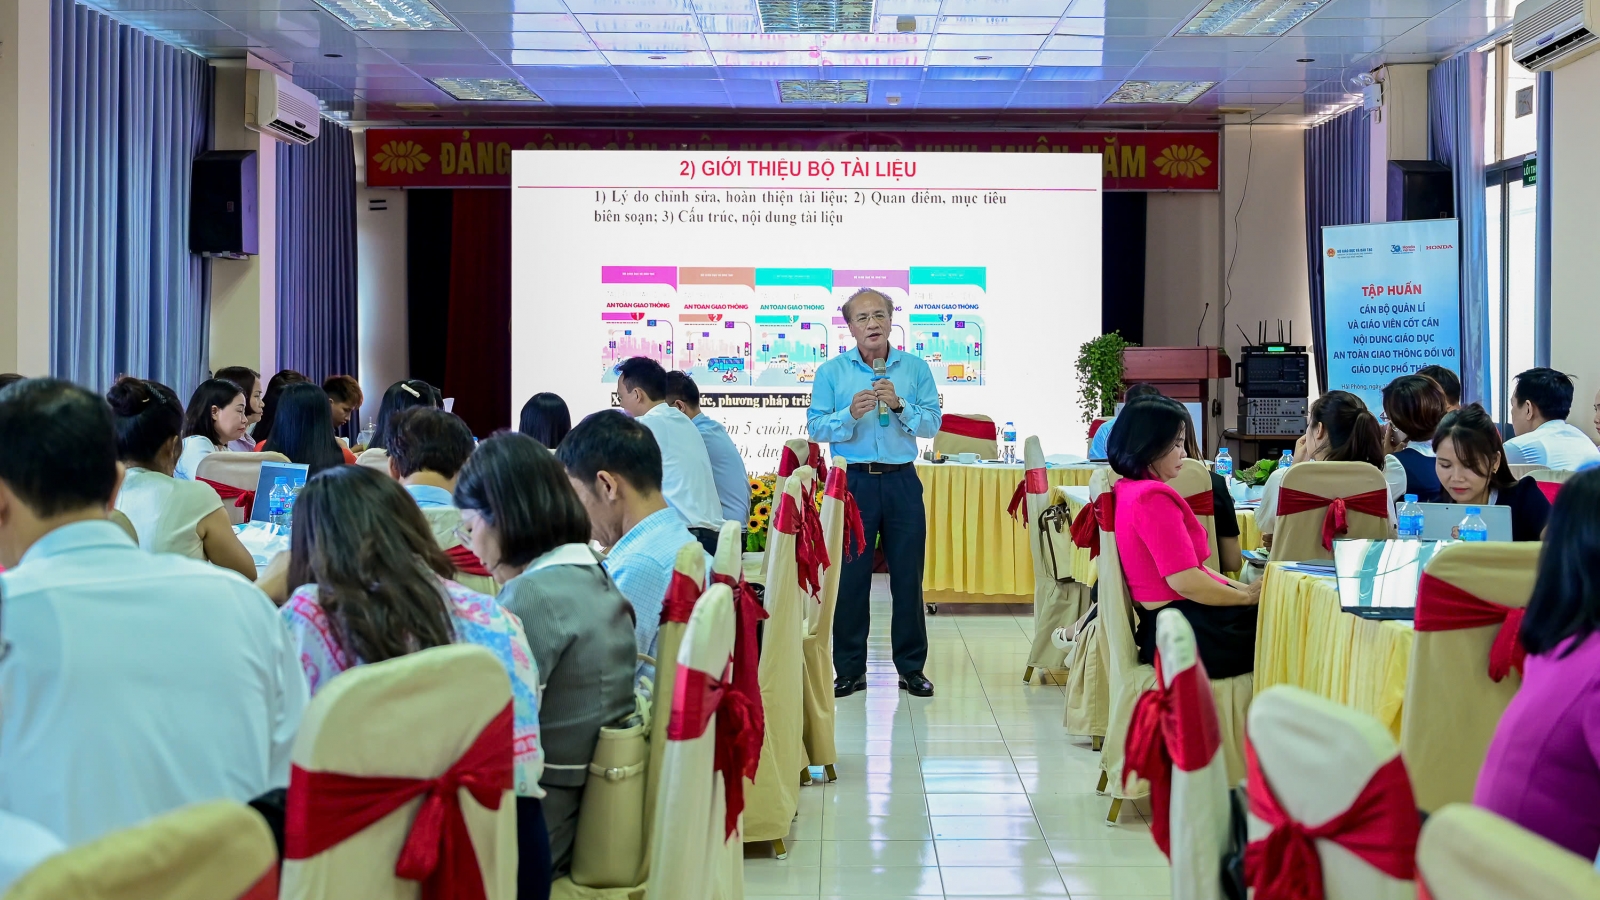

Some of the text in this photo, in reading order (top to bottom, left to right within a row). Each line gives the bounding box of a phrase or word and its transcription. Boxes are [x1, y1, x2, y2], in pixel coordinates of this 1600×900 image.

[1082, 137, 1146, 178] ĂM
[680, 156, 917, 181] 2) GIỚI THIỆU BỘ TÀI LIỆU
[595, 190, 606, 205] 1)
[612, 190, 628, 206] Lý
[634, 190, 649, 203] do
[726, 190, 756, 203] hoàn
[762, 190, 793, 206] thiện
[799, 190, 815, 203] tài
[821, 190, 848, 206] liệu;
[854, 191, 866, 206] 2)
[871, 190, 906, 206] Quan
[951, 194, 978, 207] mục
[983, 191, 1007, 204] tiêu
[594, 206, 843, 226] biên soạn; 3) Cấu trúc, nội dung tài liệu
[1361, 280, 1422, 299] TẬP HUẤN
[1360, 304, 1377, 314] CÁN
[1378, 303, 1390, 316] BỘ
[1417, 302, 1426, 312] LÍ
[1347, 316, 1440, 330] VÀ GIÁO VIÊN CỐT CÁN
[1353, 333, 1435, 346] NỘI DUNG GIÁO DỤC
[1333, 346, 1455, 360] AN TOÀN GIAO THÔNG ĐỐI VỚI
[1351, 363, 1371, 374] GIÁO
[1372, 365, 1390, 376] DỤC
[700, 394, 716, 408] ức,
[718, 394, 760, 408] phương
[762, 394, 789, 408] pháp
[743, 421, 752, 435] 5
